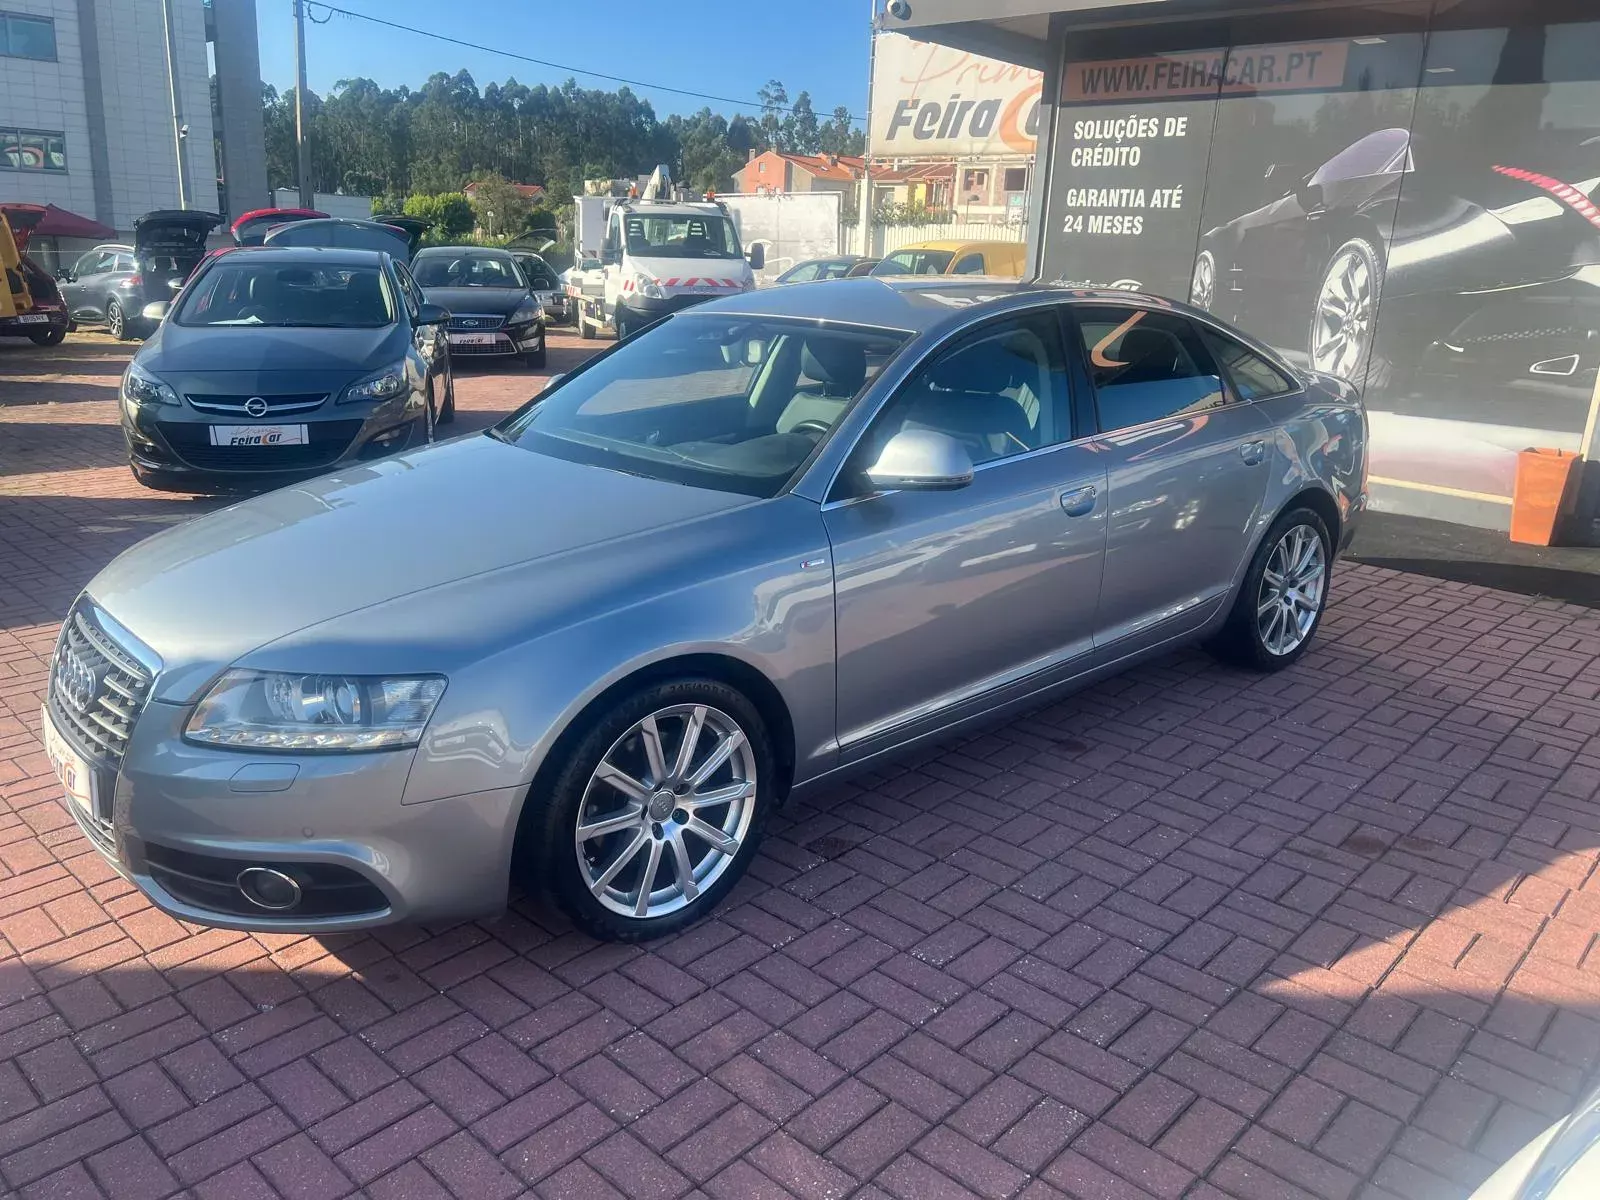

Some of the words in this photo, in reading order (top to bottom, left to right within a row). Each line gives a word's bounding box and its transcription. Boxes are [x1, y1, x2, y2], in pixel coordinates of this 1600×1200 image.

[1081, 51, 1322, 94] WWW.FEIRACAR.PT
[1073, 114, 1159, 143] SOLUÇÕES
[1163, 116, 1188, 137] DE
[1070, 143, 1141, 167] CRÉDITO
[1066, 188, 1145, 208] GARANTIA
[1150, 184, 1182, 209] ATÉ
[1063, 214, 1083, 233] 24
[1087, 215, 1144, 234] MESES
